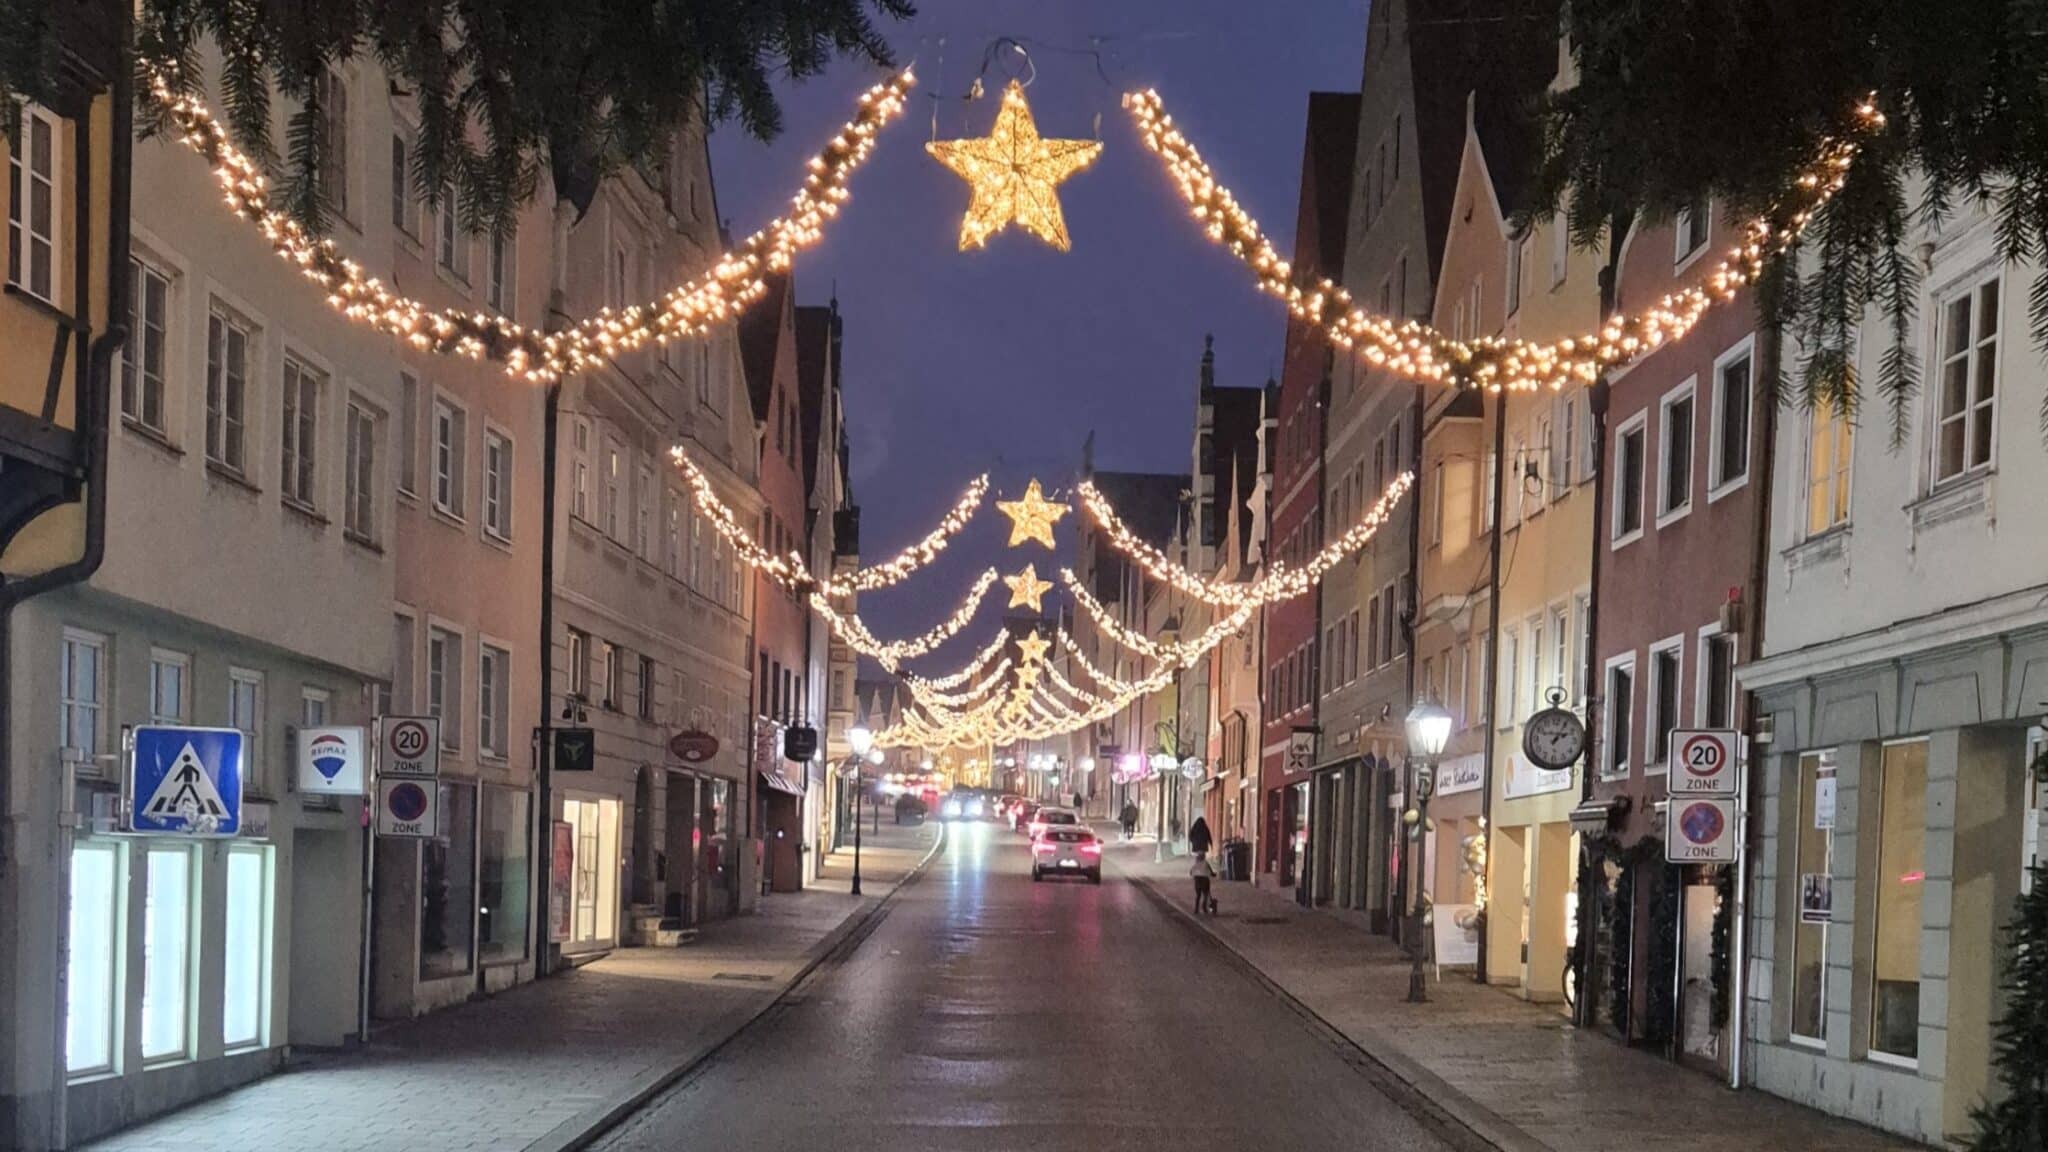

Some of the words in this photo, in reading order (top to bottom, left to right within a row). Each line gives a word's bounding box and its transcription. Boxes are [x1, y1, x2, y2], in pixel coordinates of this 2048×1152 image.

[399, 730, 420, 749] 20
[311, 746, 346, 756] RE/MAX
[1692, 746, 1718, 765] 20
[394, 761, 423, 771] ZONE
[1686, 779, 1720, 790] ZONE
[392, 823, 422, 833] ZONE
[1685, 847, 1718, 857] ZONE
